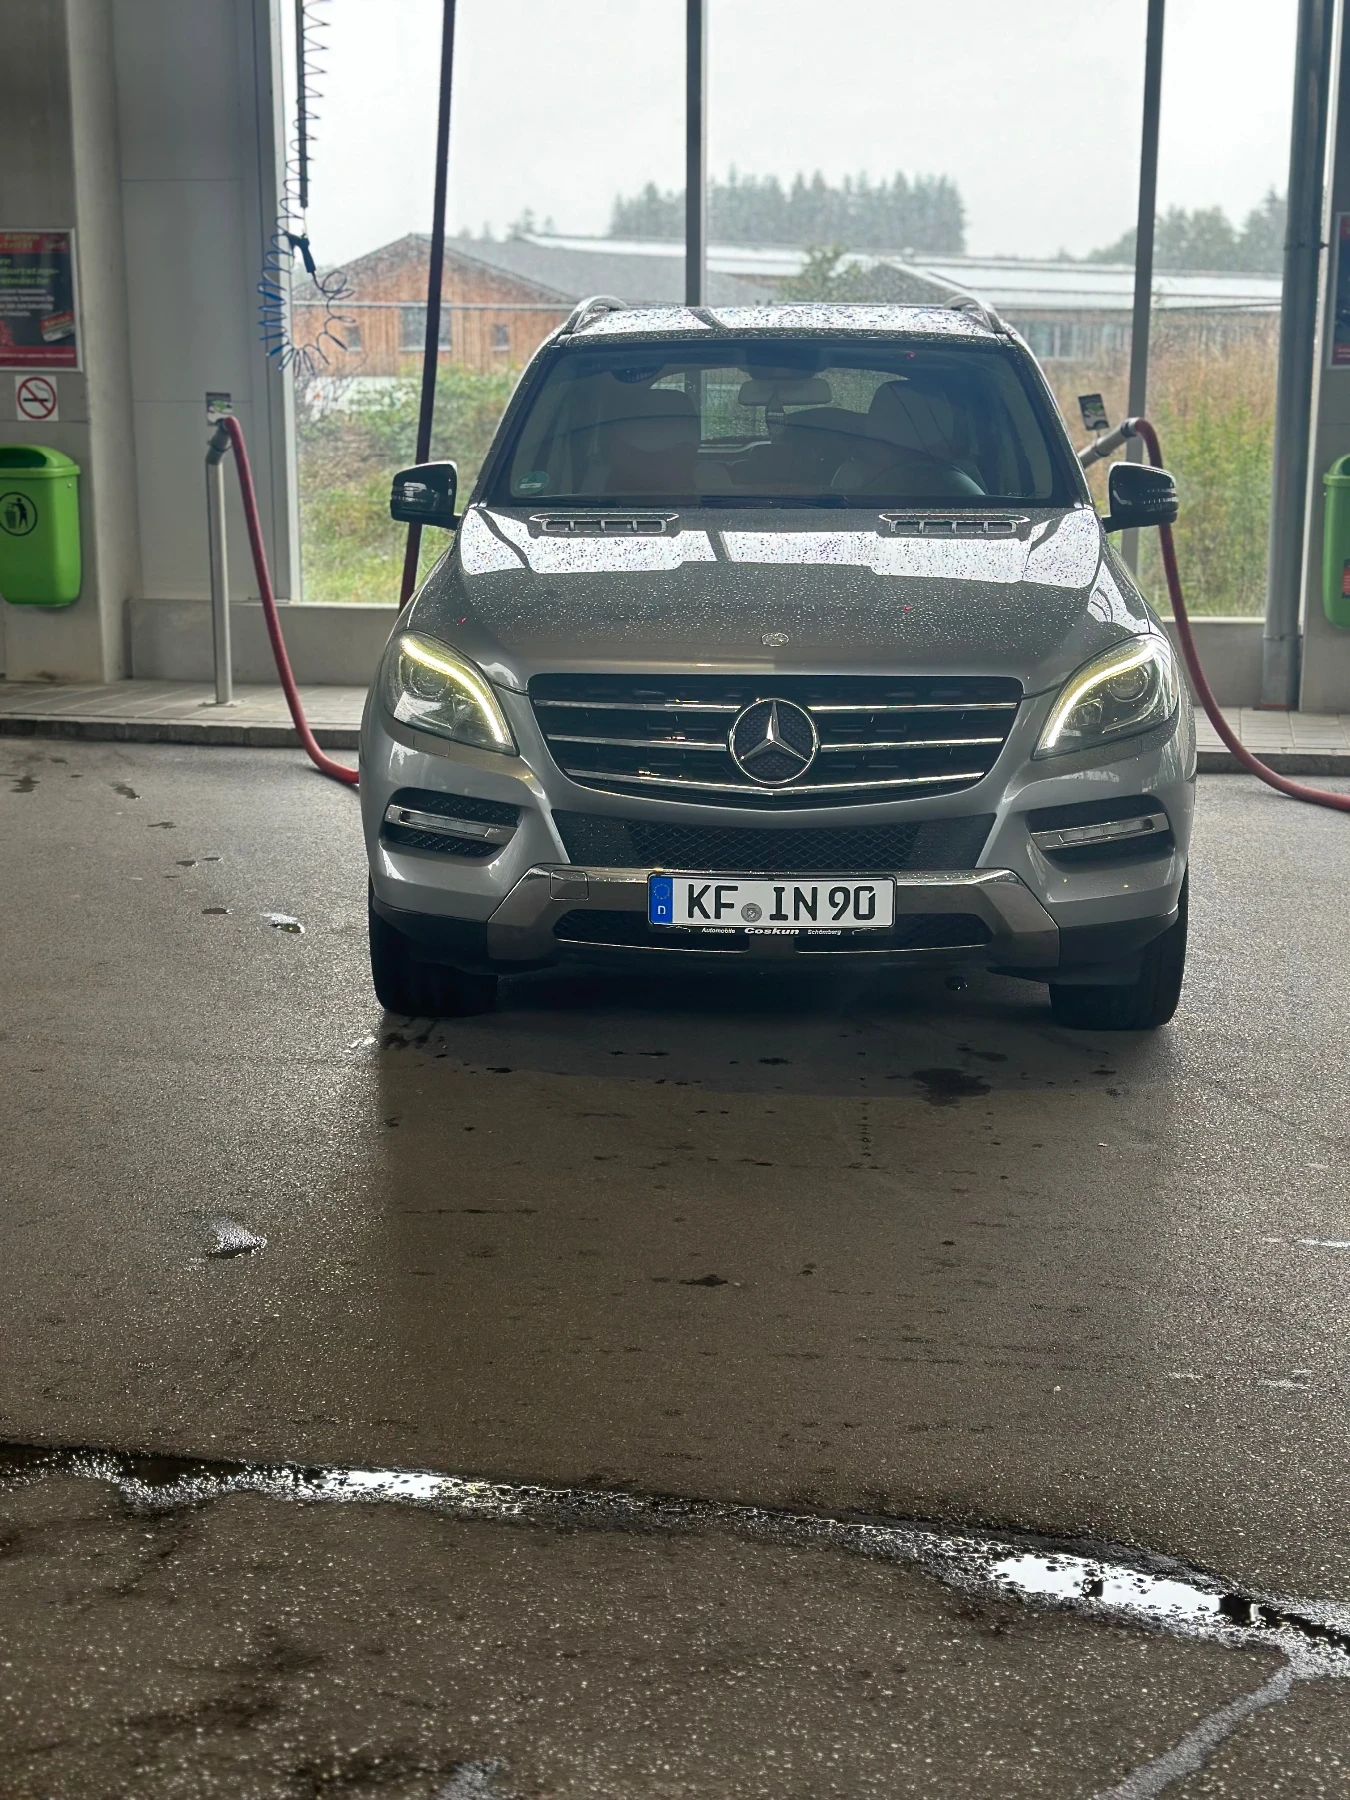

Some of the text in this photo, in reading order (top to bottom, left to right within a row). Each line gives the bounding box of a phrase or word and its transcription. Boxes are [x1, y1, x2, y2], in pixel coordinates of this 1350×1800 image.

[687, 883, 876, 921] KF IN 90
[657, 905, 666, 915] D
[744, 927, 800, 935] Coskun
